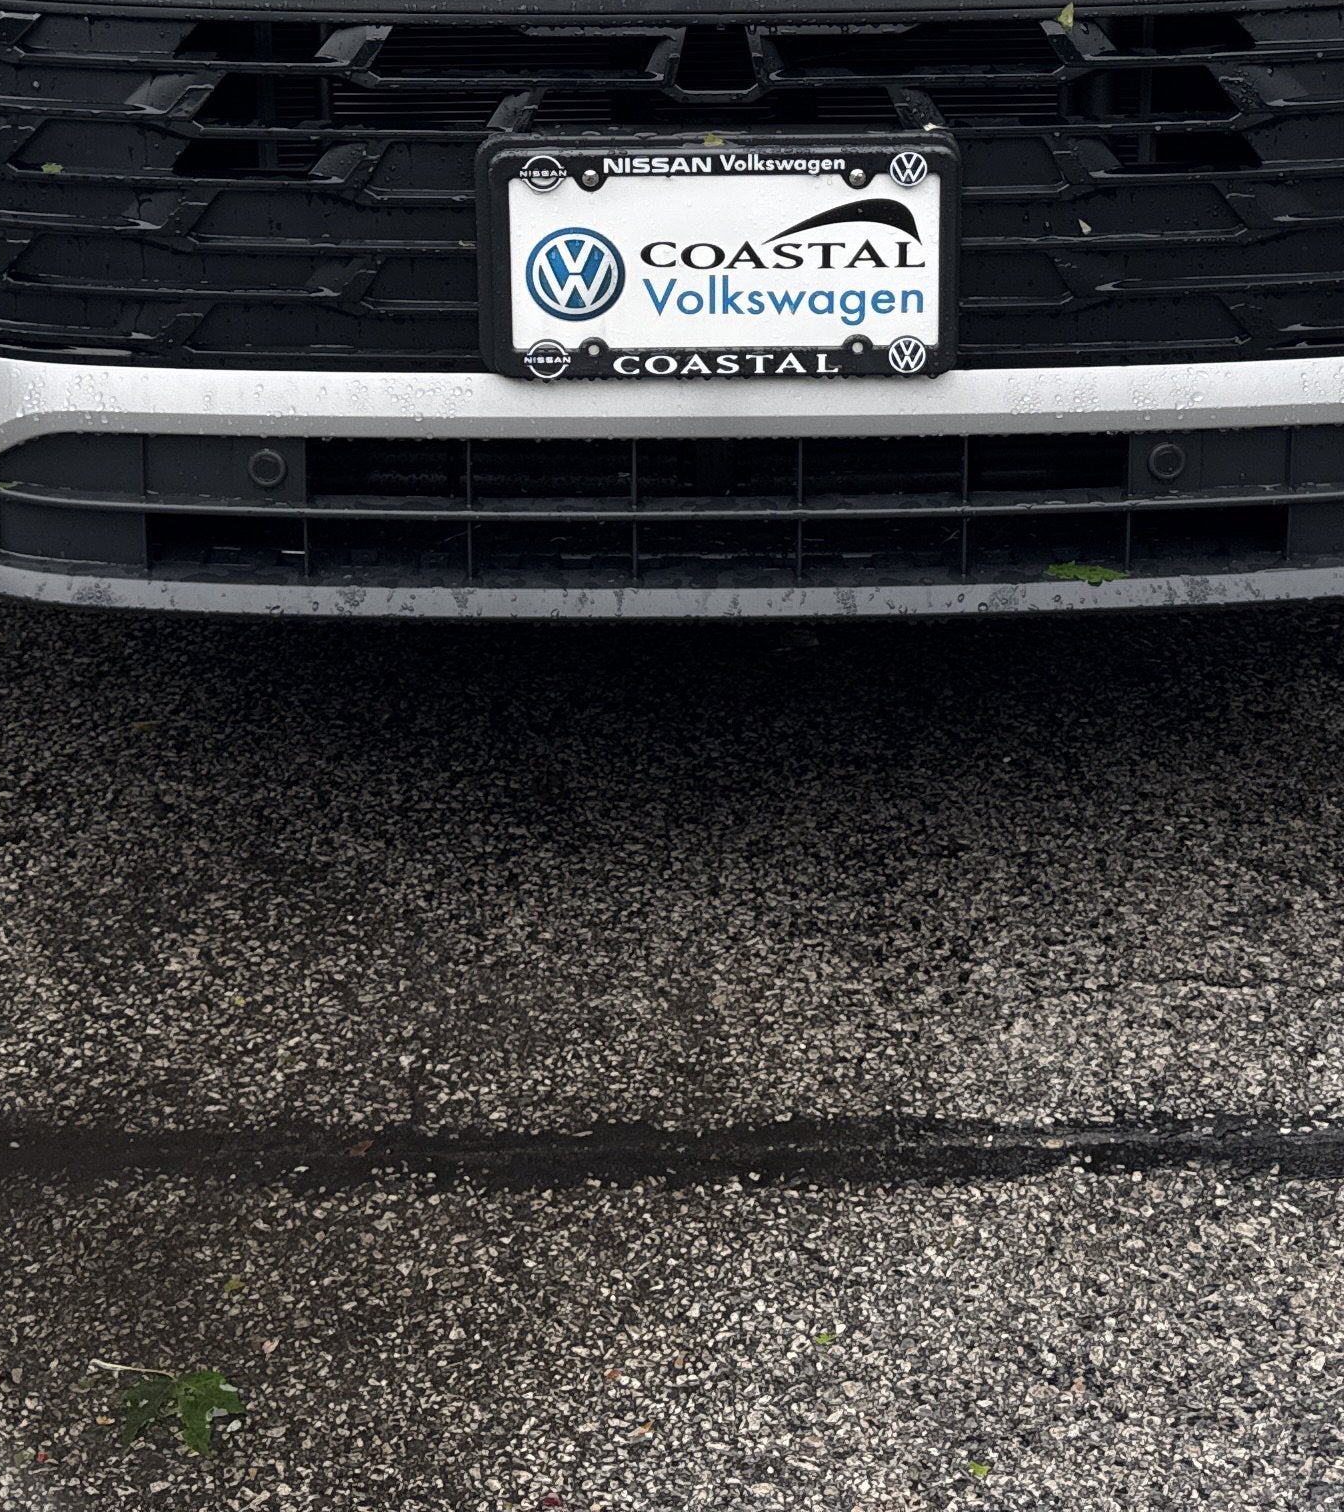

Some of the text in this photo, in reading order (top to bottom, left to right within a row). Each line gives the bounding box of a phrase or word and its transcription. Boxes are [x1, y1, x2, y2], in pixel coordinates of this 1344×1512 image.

[519, 169, 568, 178] NISSAN
[603, 153, 846, 174] NISSAN Volkswagen
[890, 152, 927, 186] VW
[640, 240, 926, 270] COASTAL
[528, 231, 623, 318] VW
[643, 275, 925, 326] Volkswagen
[523, 356, 572, 366] NISSAN
[613, 353, 840, 375] COASTAL
[889, 337, 926, 372] VW
